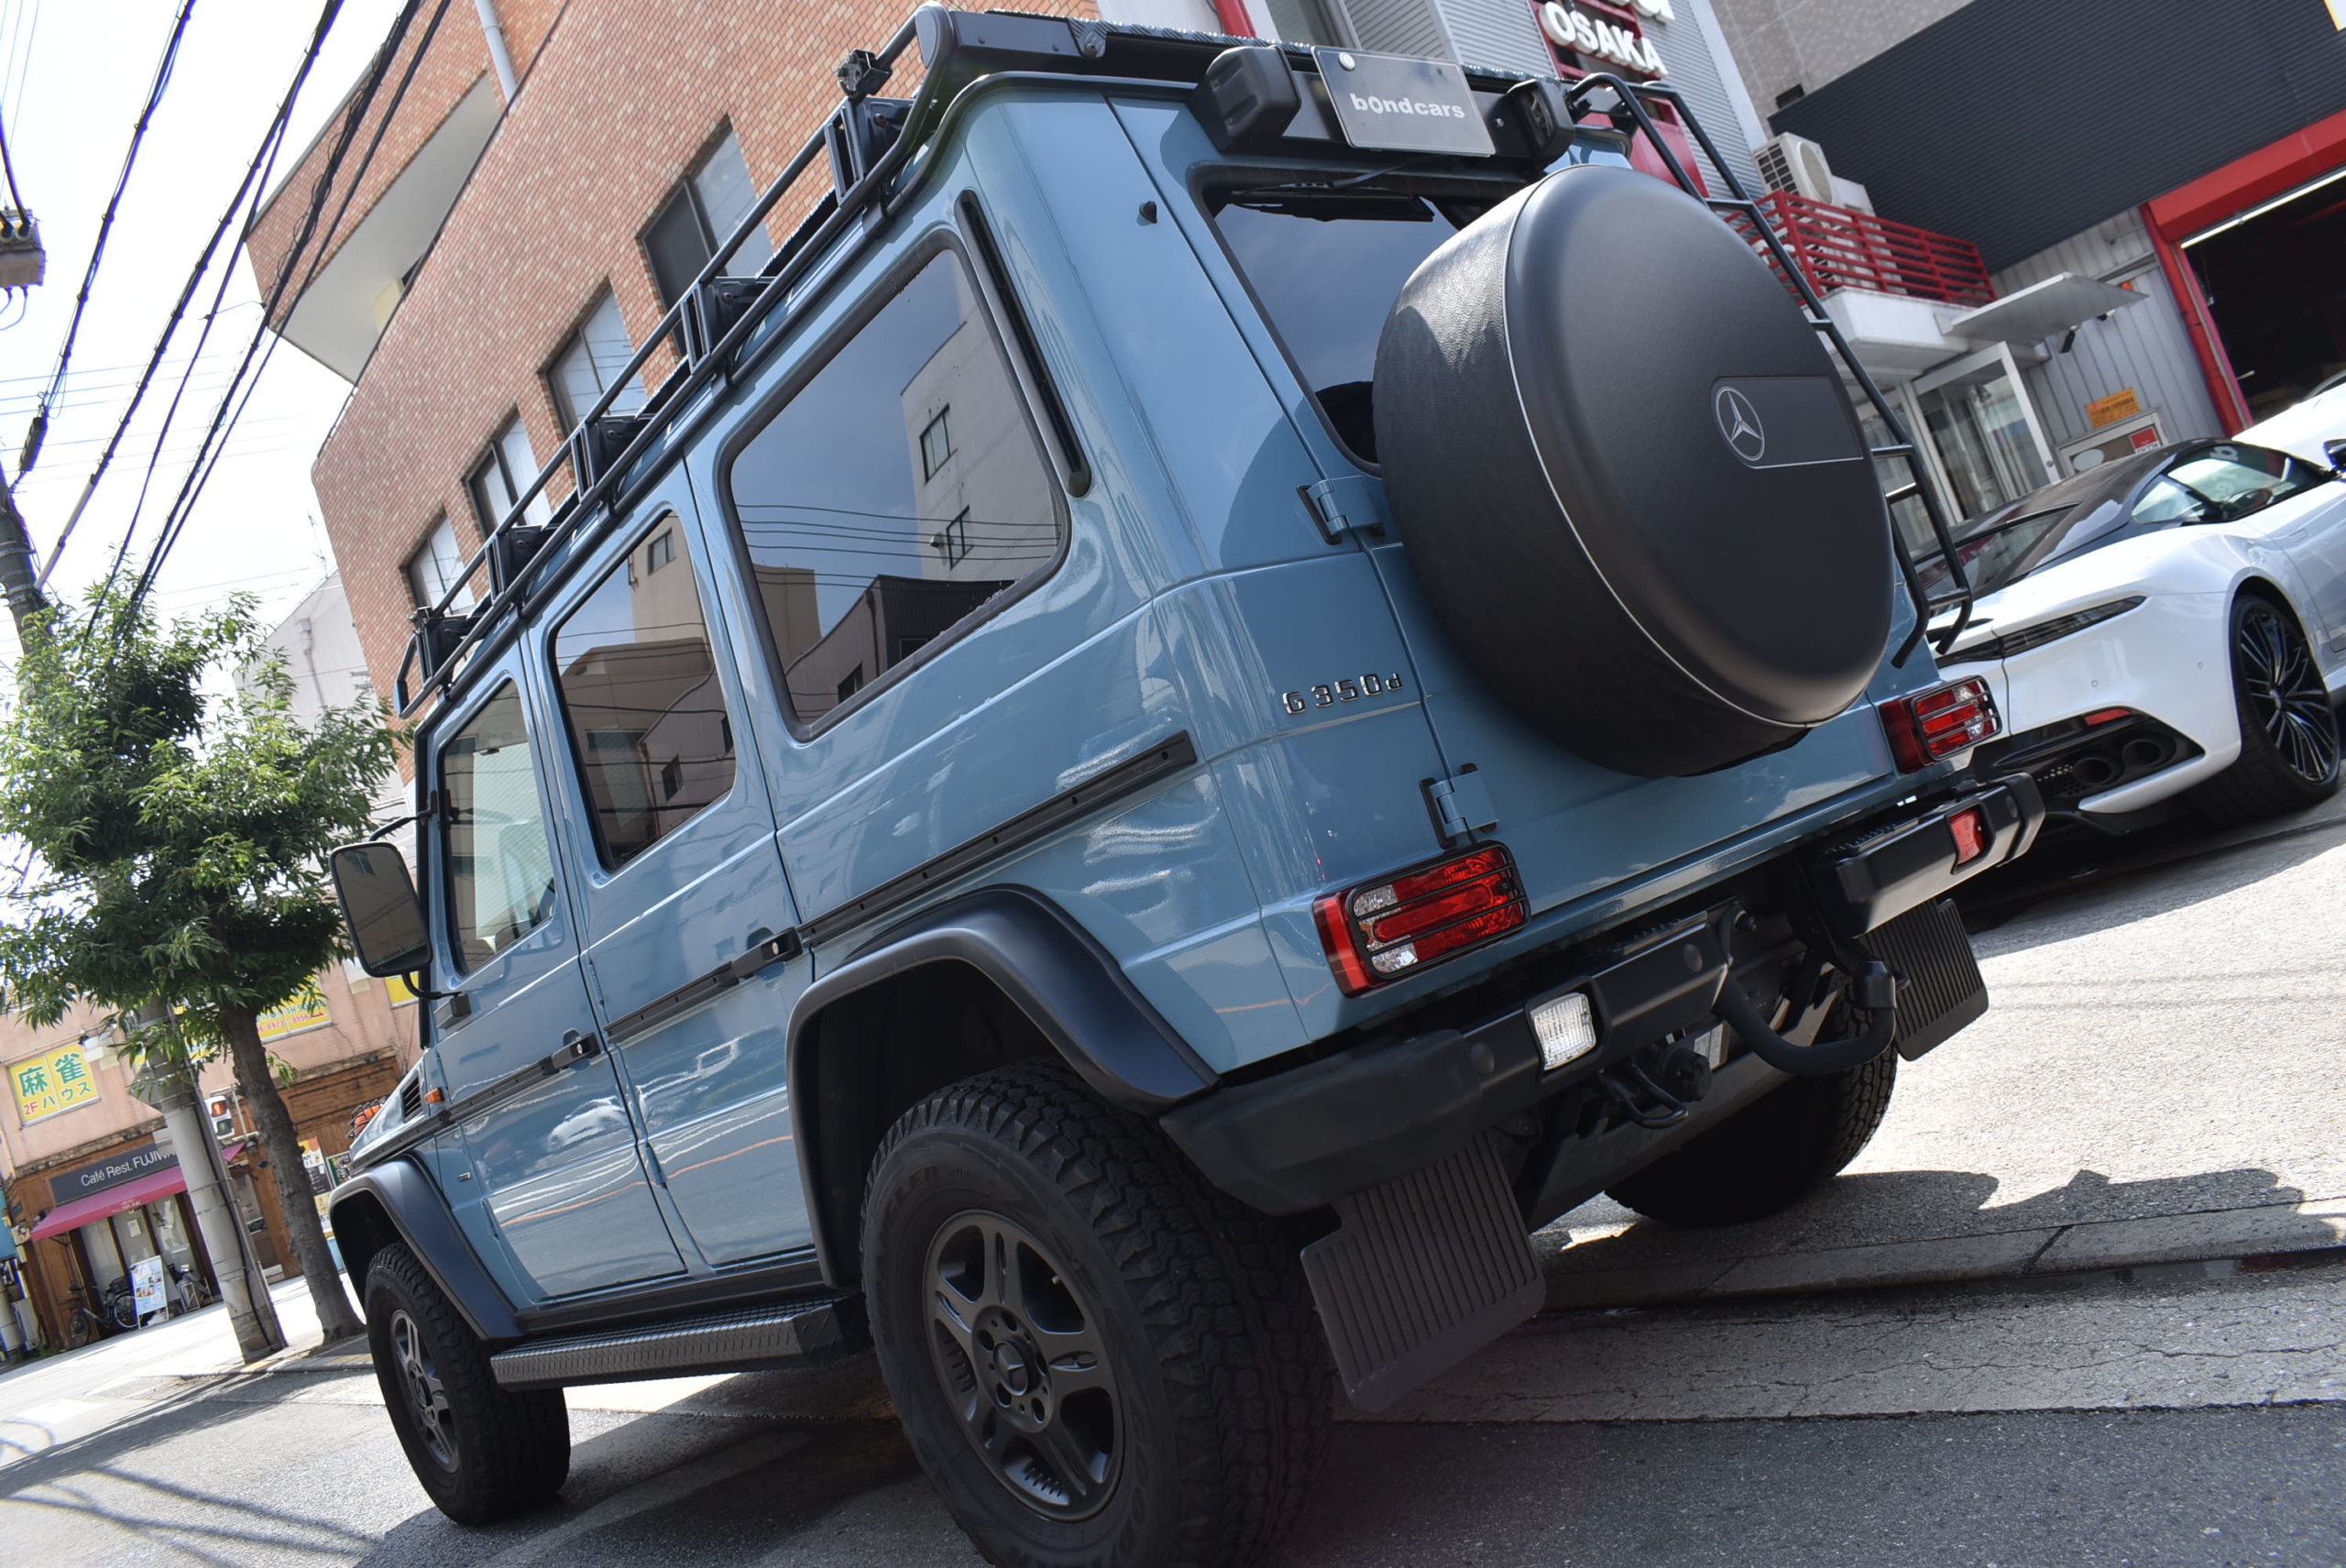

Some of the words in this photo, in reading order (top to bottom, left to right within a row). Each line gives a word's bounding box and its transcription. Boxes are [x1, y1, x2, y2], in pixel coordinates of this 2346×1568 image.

[1540, 2, 1669, 77] OSAKA
[18, 1053, 86, 1098] 麻雀
[23, 1101, 38, 1115] 2F
[42, 1081, 91, 1109] ハウス
[81, 1169, 105, 1187] Café
[133, 1149, 176, 1169] FUJI
